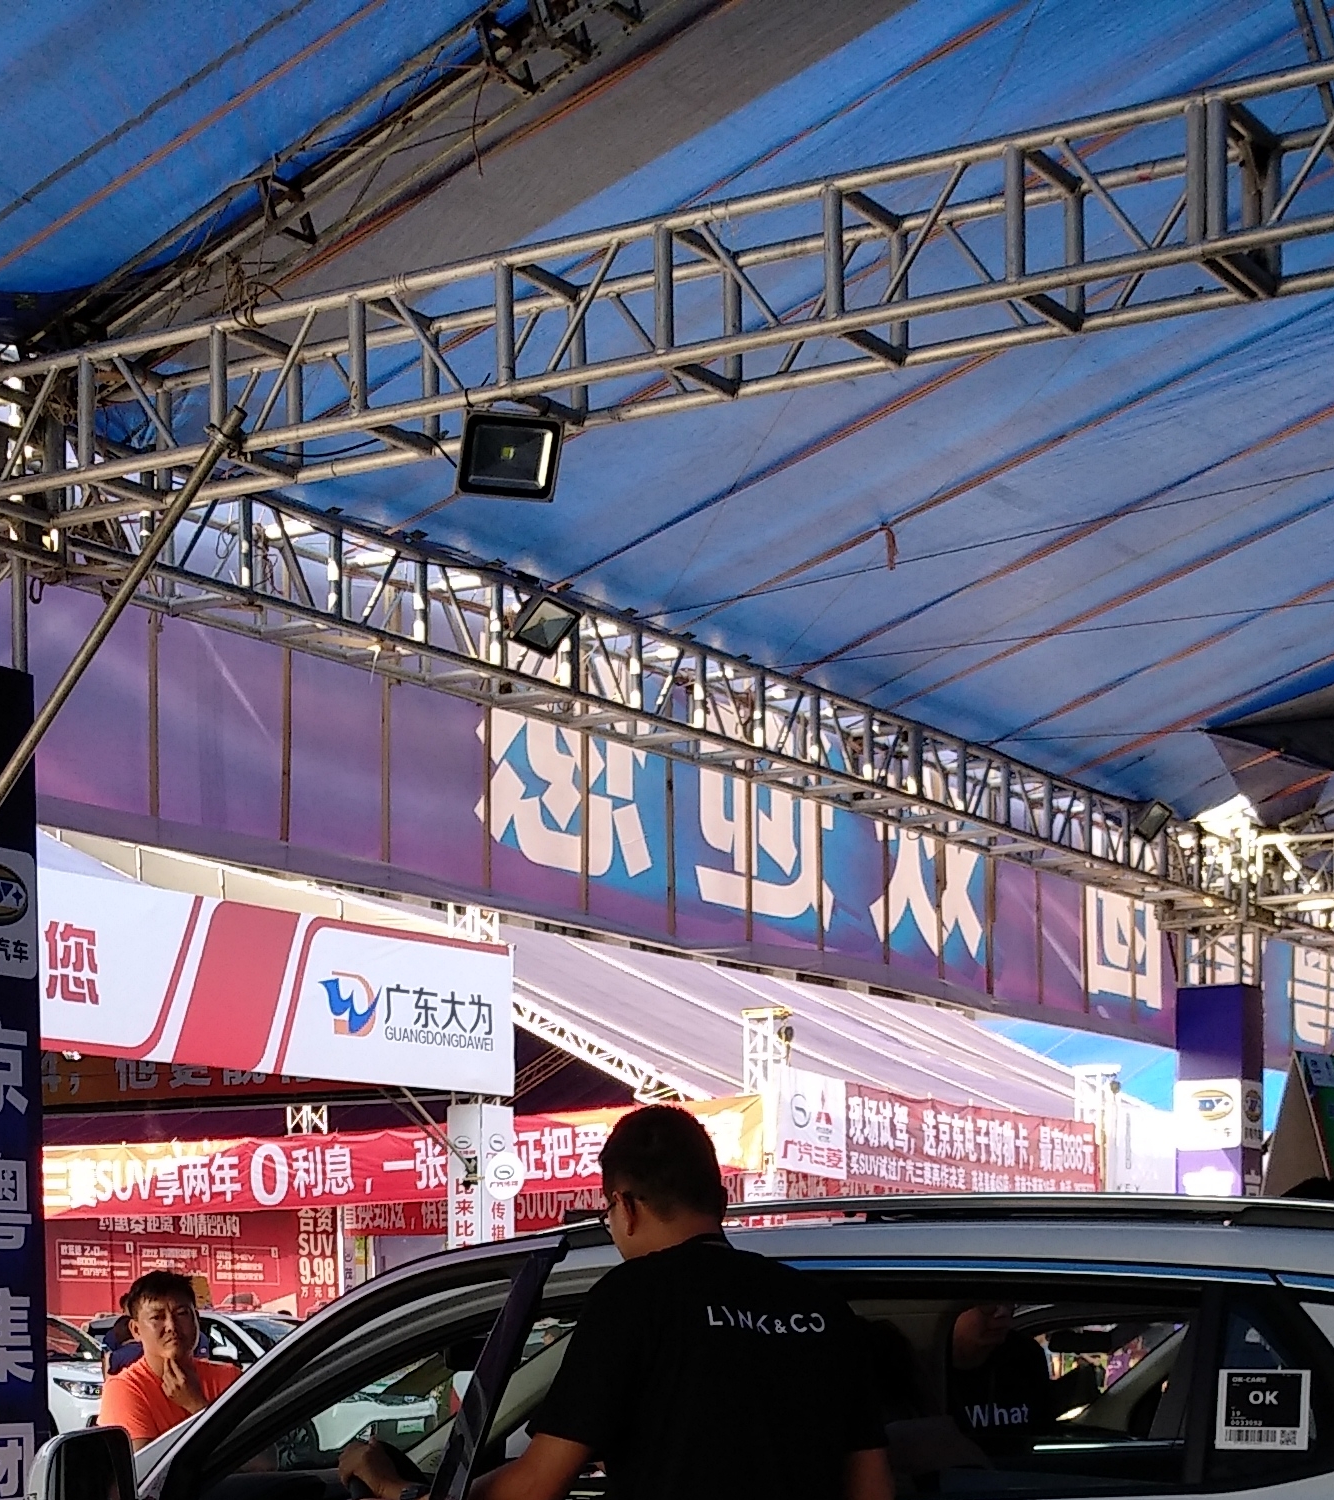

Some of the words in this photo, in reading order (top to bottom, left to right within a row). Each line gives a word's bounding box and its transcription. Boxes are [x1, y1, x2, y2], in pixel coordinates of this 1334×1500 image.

[44, 919, 101, 1006] 您
[384, 983, 494, 1034] 广东大为
[384, 1025, 494, 1052] GUANGDONGDAWEI
[781, 1139, 844, 1170] 广汽三菱
[298, 1233, 334, 1257] SUV
[299, 1256, 335, 1285] 9.98
[706, 1304, 825, 1334] LINK&CO
[1248, 1390, 1279, 1405] OK
[965, 1402, 1030, 1432] What
